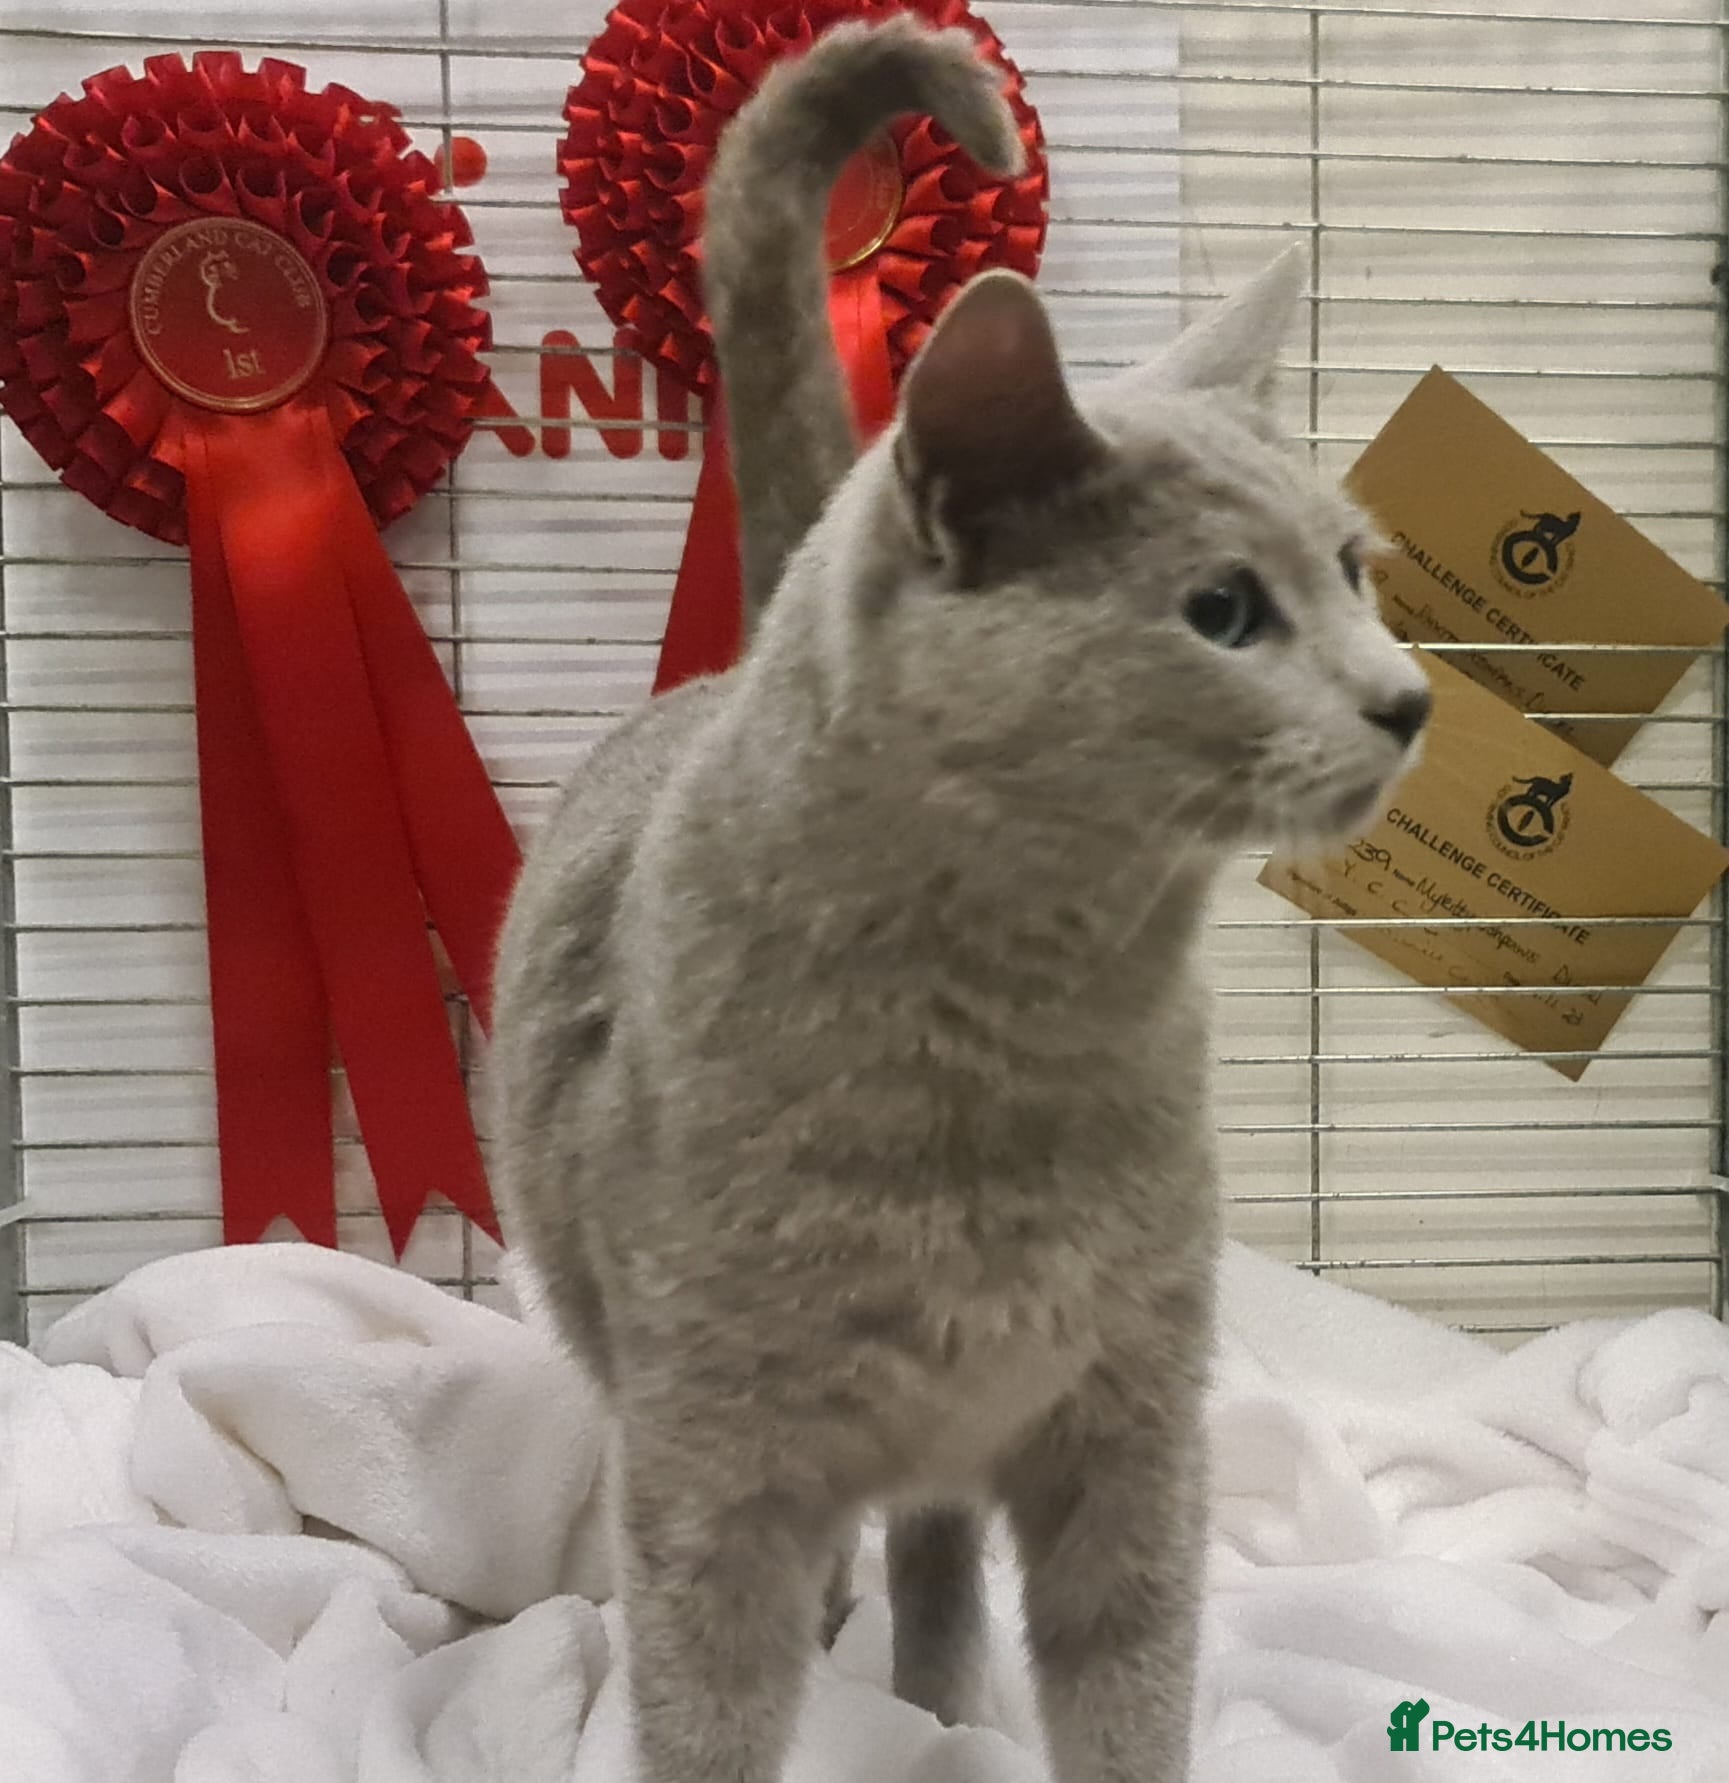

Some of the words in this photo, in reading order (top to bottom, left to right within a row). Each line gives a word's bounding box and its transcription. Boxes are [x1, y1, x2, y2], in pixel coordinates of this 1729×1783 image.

[143, 229, 228, 336] CUMBERLAND
[222, 348, 266, 380] 1st
[1391, 530, 1487, 614] CHALLENGE
[1386, 808, 1486, 879] CHALLENGE
